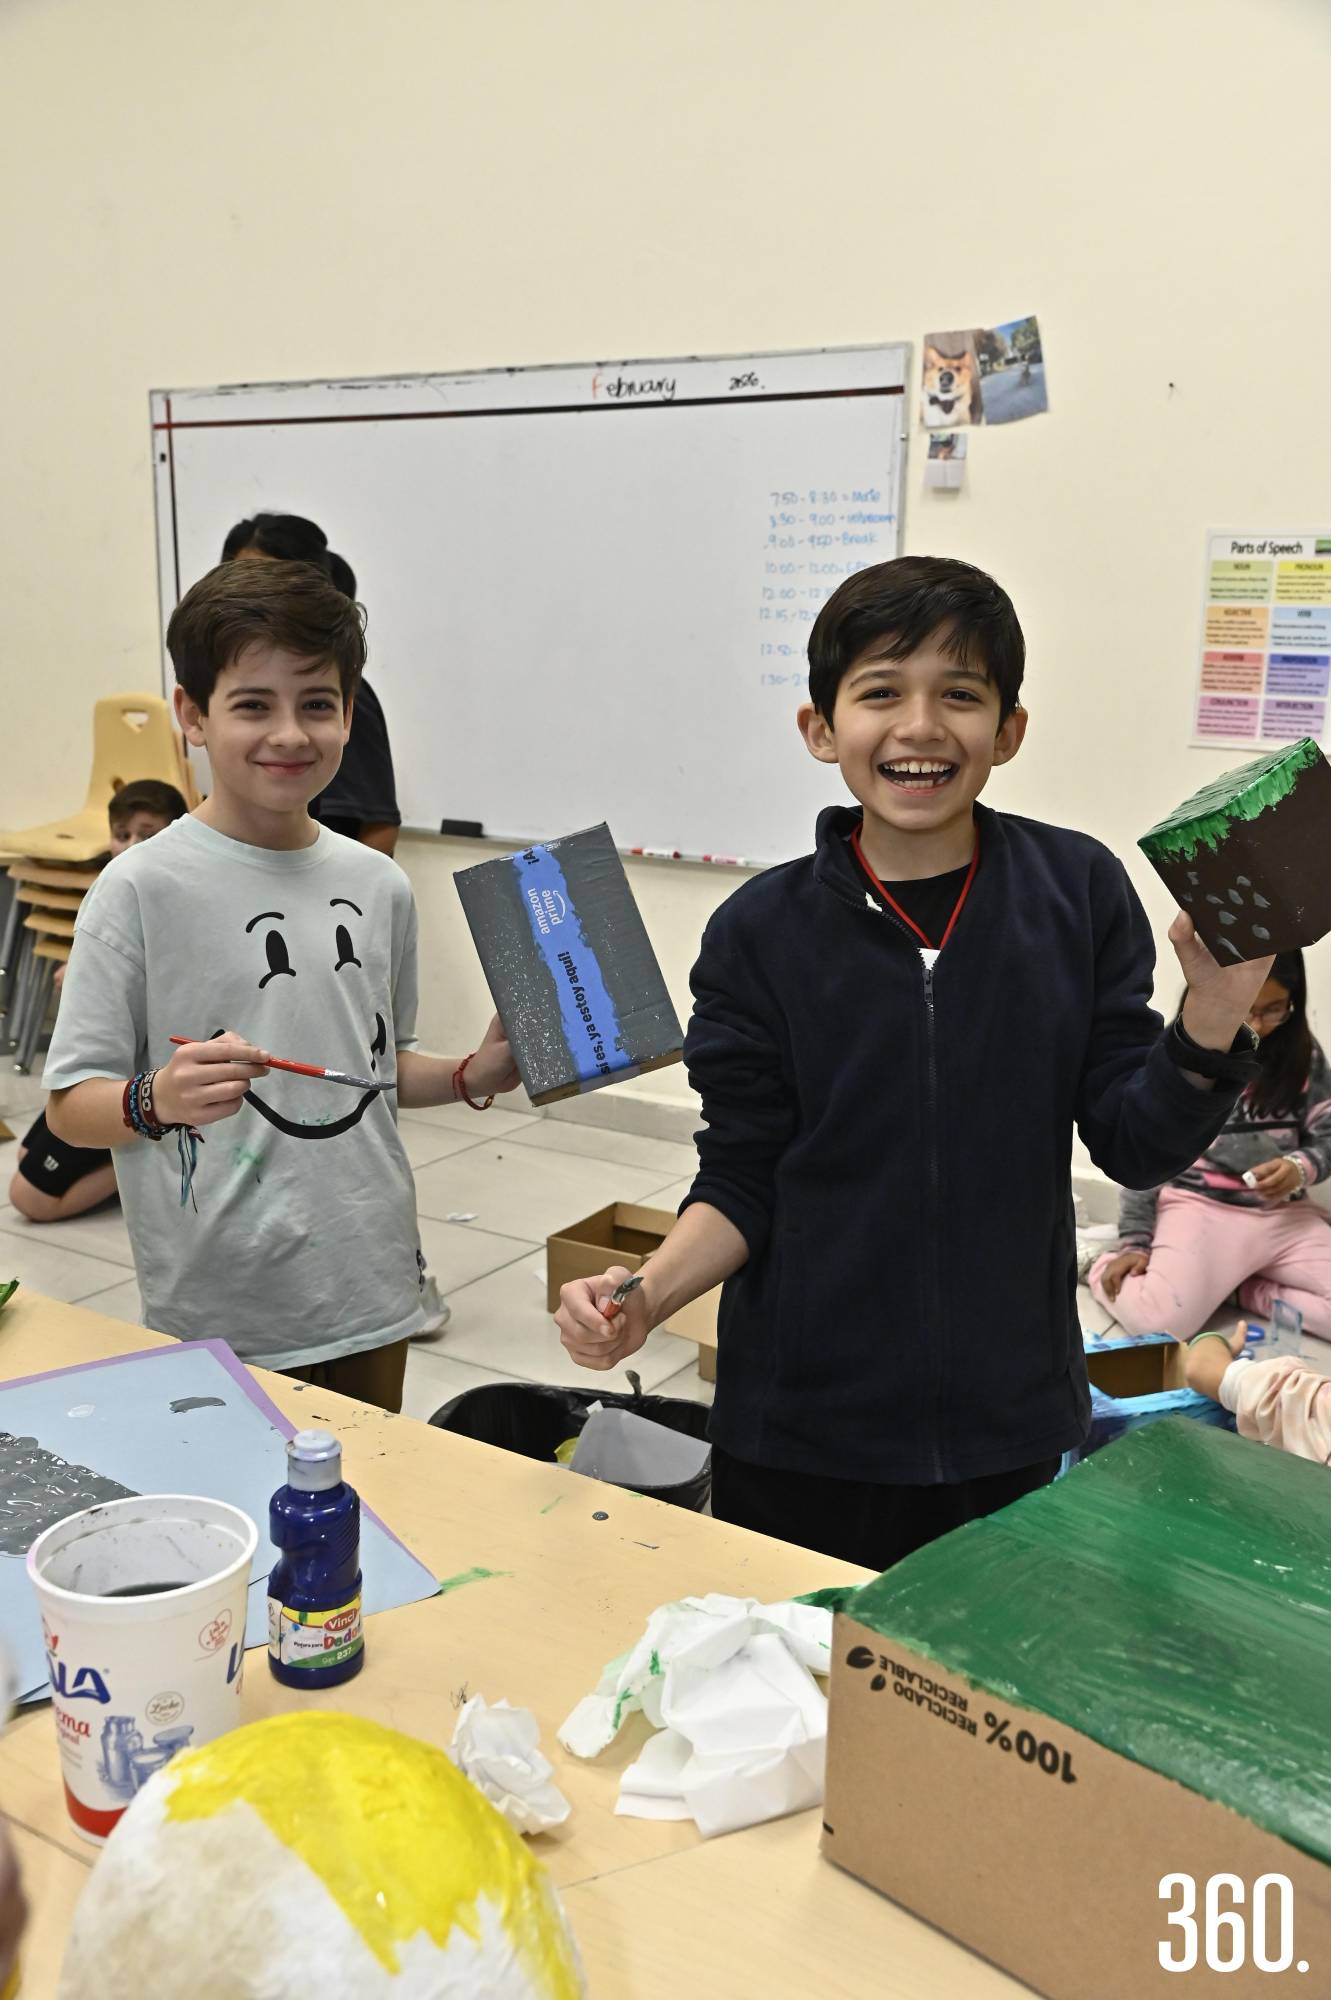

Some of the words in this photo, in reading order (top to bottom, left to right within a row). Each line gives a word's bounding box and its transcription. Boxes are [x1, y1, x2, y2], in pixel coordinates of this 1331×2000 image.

[1231, 541, 1254, 554] Parts
[1256, 541, 1267, 554] of
[1268, 542, 1303, 557] Speech
[527, 887, 551, 935] amazon
[541, 889, 564, 926] prime
[572, 986, 592, 1023] estoy
[586, 1023, 602, 1041] ya
[328, 1610, 355, 1630] Vinci
[336, 1647, 352, 1660] 237
[878, 1654, 969, 1712] RECICLABLE
[893, 1681, 978, 1737] RECICLADO
[984, 1711, 1077, 1784] 100%
